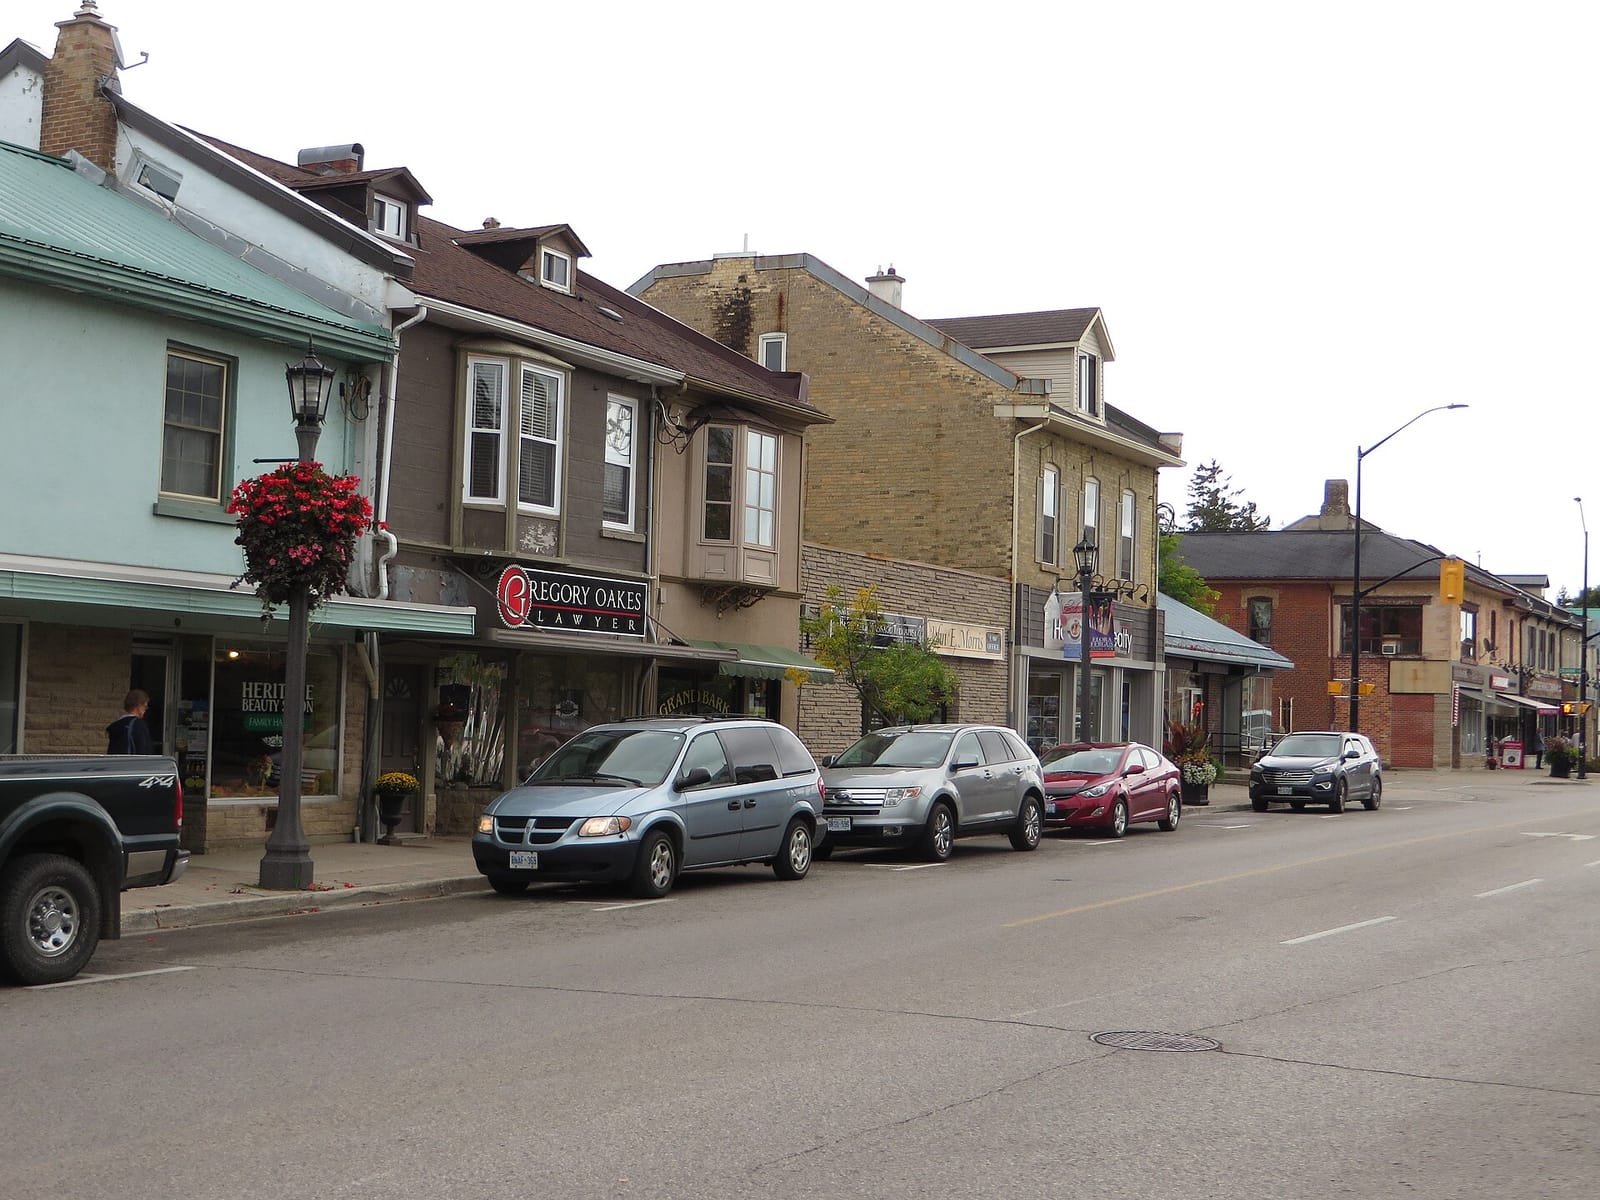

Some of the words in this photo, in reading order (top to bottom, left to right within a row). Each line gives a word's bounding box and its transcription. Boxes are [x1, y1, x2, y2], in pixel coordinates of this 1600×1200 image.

[504, 575, 590, 618] GREGORY
[595, 588, 642, 610] OAKES
[537, 610, 636, 631] LAWYER
[242, 681, 314, 700] HERITE
[242, 698, 280, 712] BEAUTY
[702, 690, 730, 714] BARK
